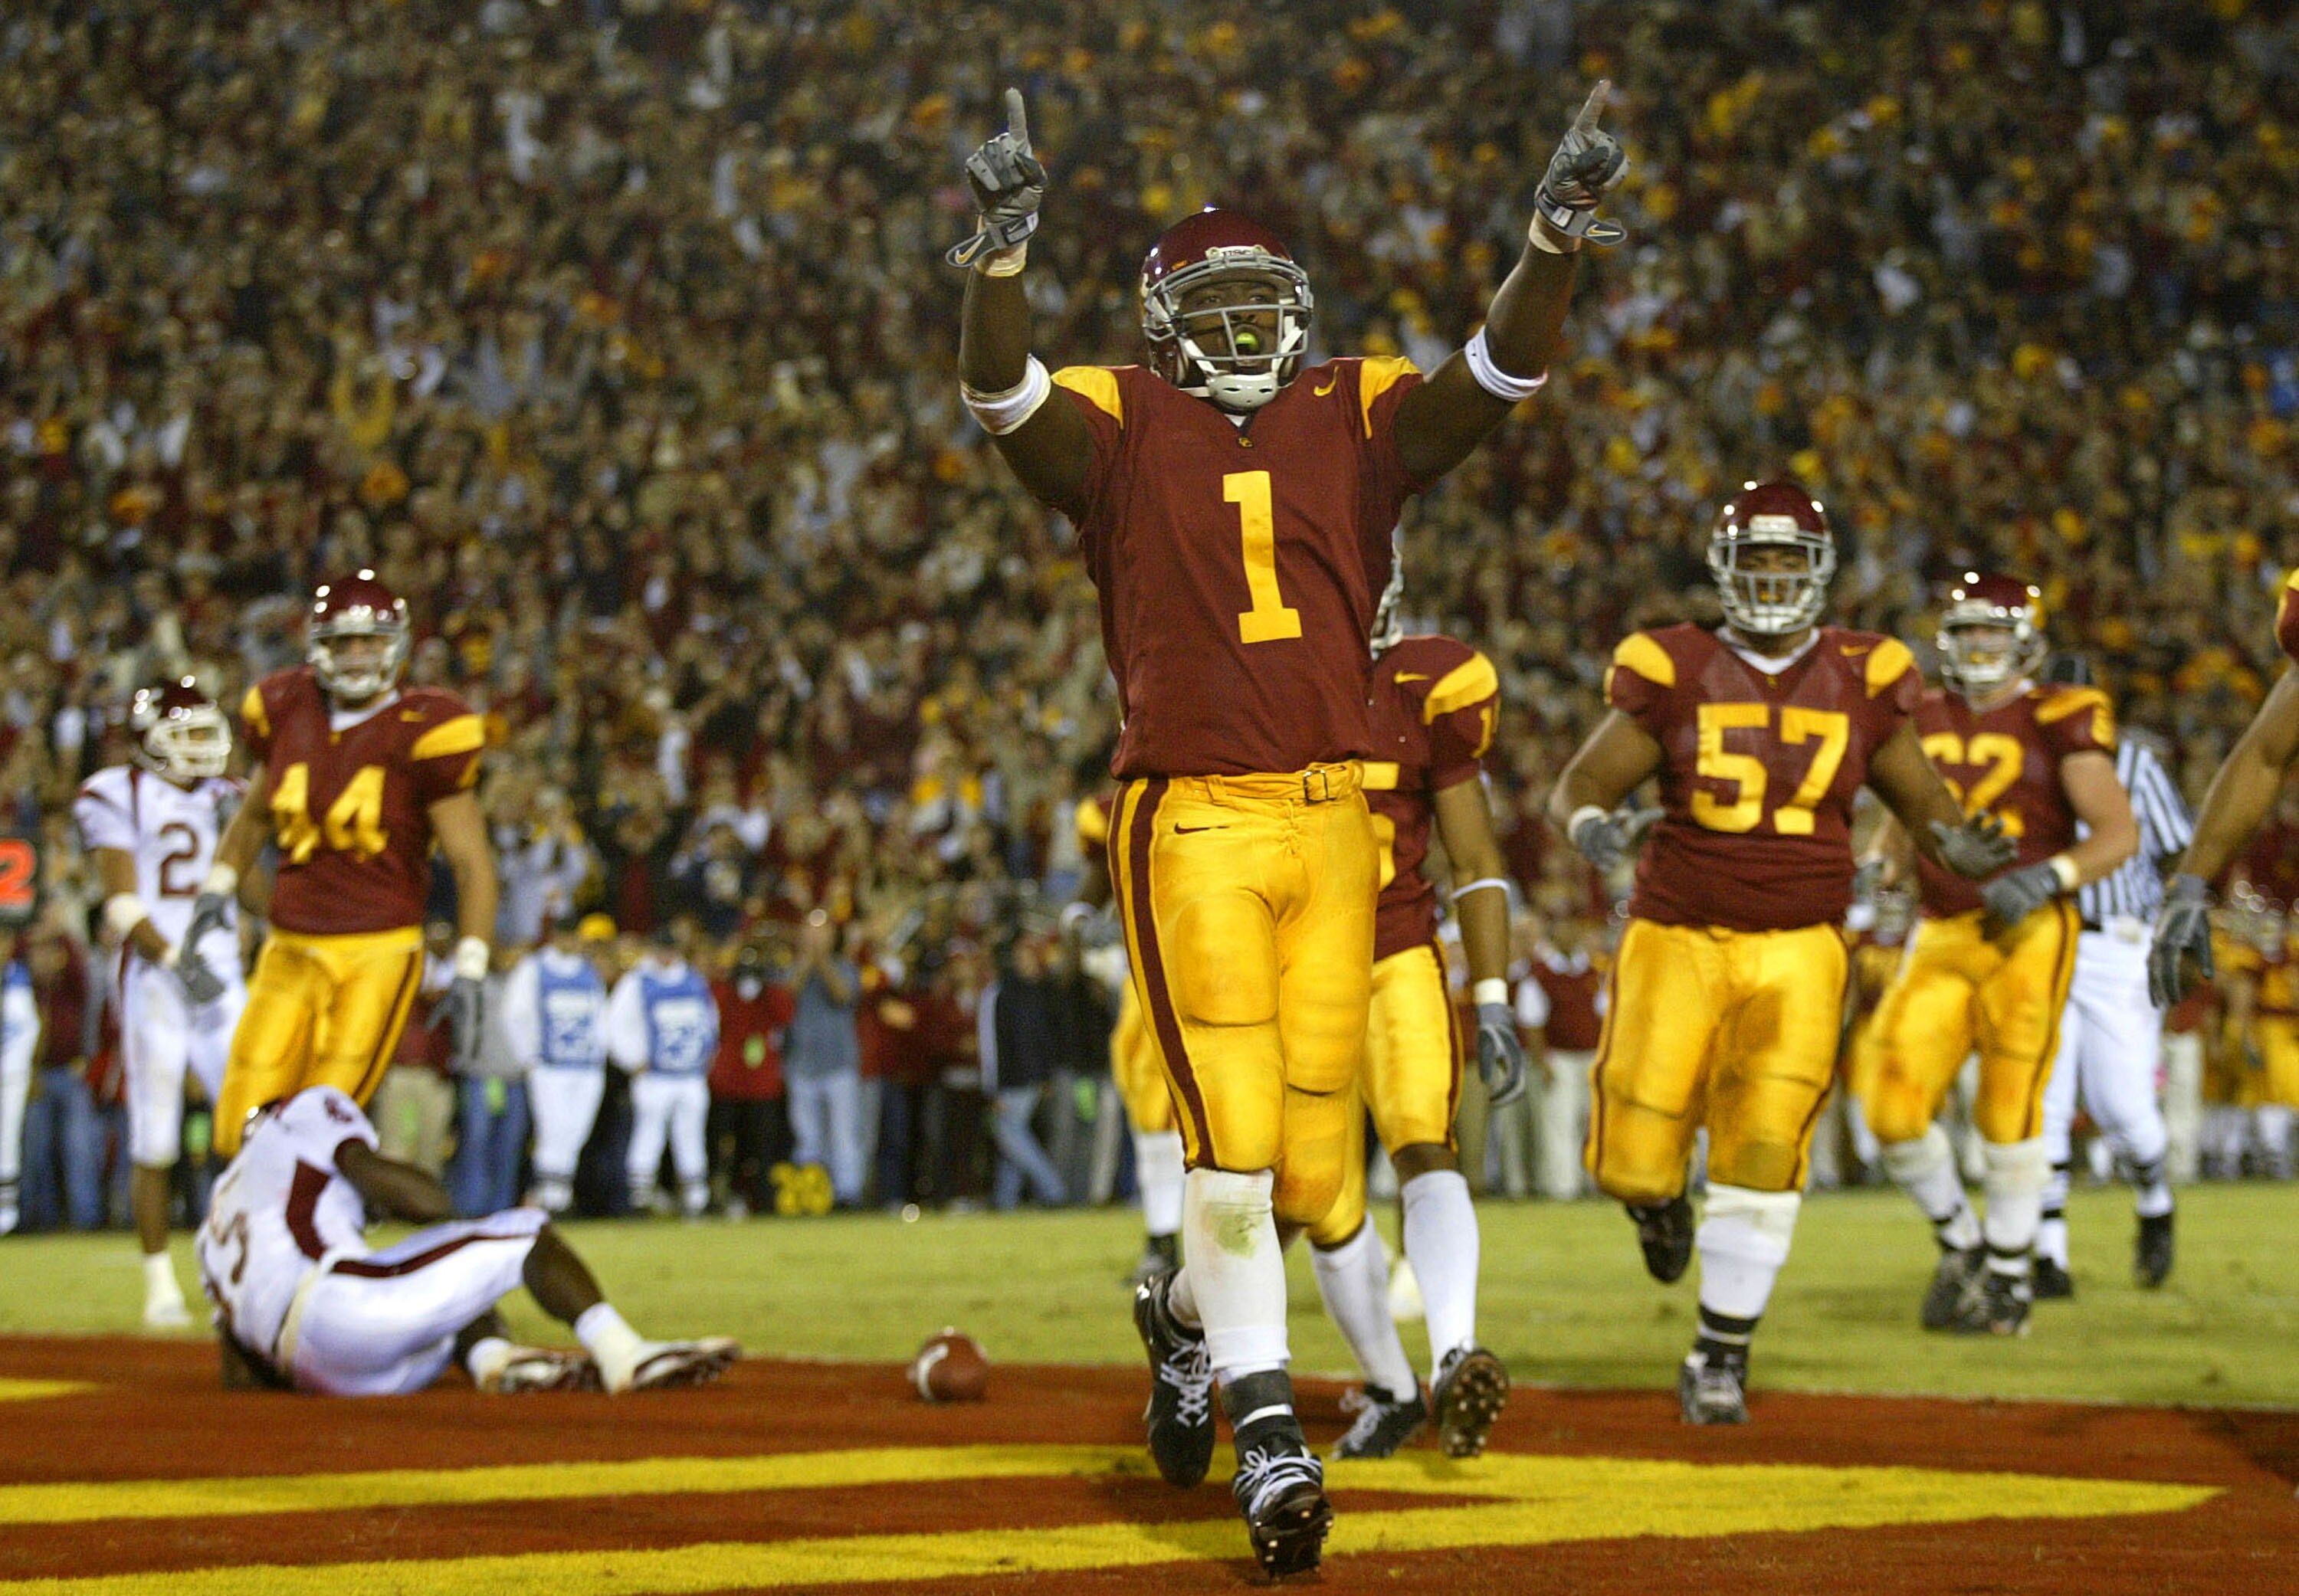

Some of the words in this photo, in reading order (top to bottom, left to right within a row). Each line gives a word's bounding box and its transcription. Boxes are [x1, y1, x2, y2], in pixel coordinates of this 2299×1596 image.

[1222, 470, 1302, 644] 1
[271, 762, 389, 865] 44
[1691, 701, 1850, 836] 57
[159, 822, 199, 899] 2
